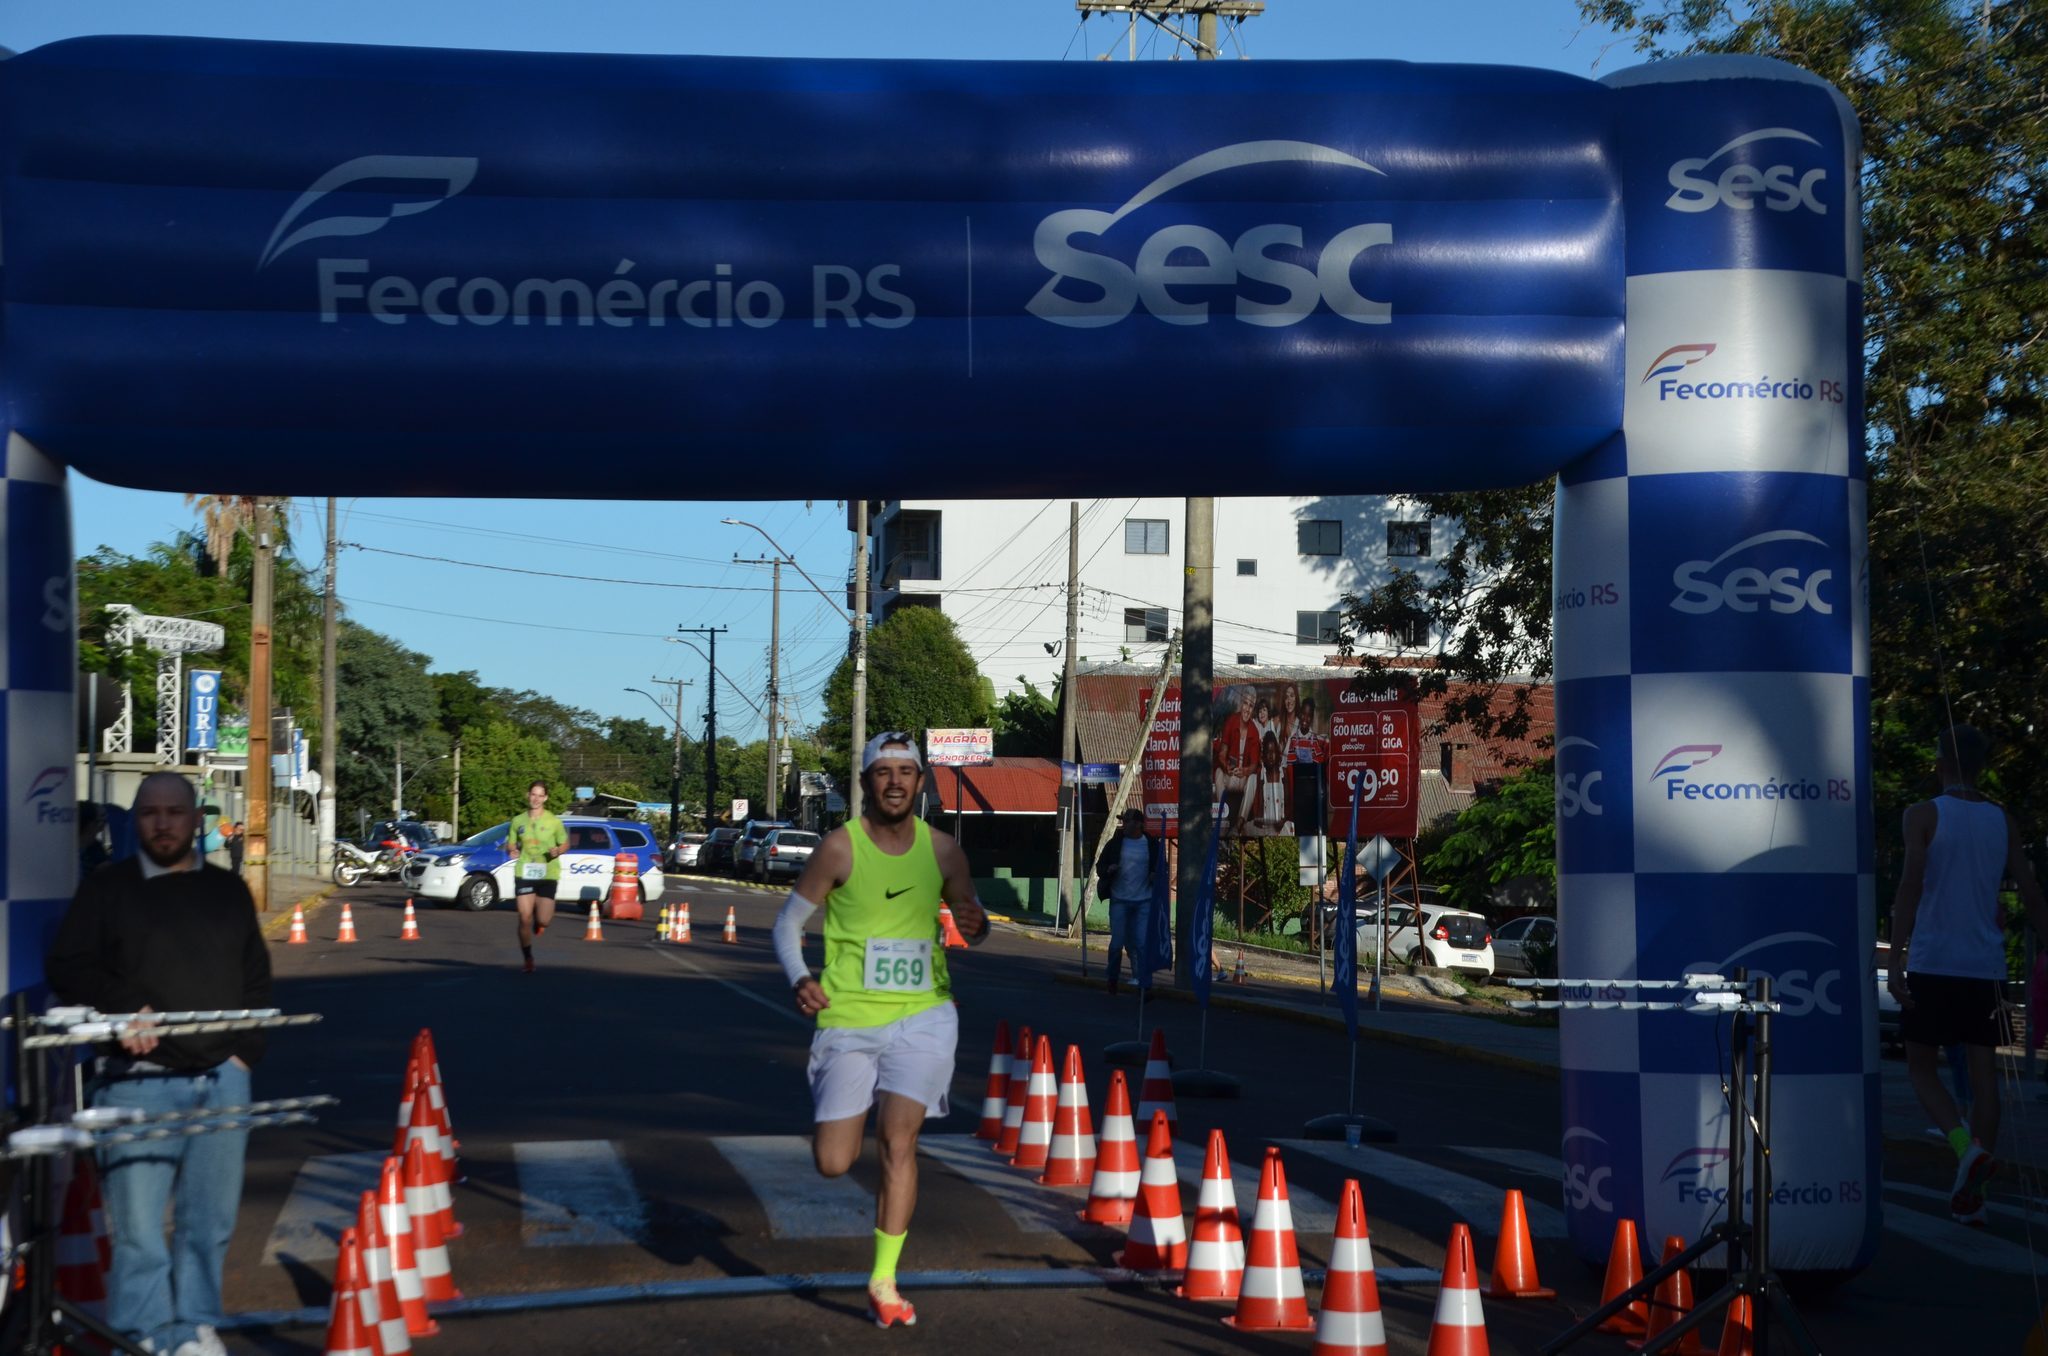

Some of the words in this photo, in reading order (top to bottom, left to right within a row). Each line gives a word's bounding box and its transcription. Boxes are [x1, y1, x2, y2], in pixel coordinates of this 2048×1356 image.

[1665, 157, 1827, 216] Sesc
[1024, 207, 1394, 328] Sesc
[316, 257, 785, 329] Fecomércio
[812, 263, 916, 329] RS
[1659, 376, 1814, 402] Fecomércio
[1820, 380, 1844, 404] RS
[1591, 583, 1620, 605] RS
[1669, 559, 1833, 615] Sesc
[194, 696, 213, 748] URI
[1333, 725, 1349, 736] 600
[1350, 724, 1374, 736] MEGA
[1382, 723, 1394, 735] 60
[1381, 738, 1403, 749] GIGA
[1154, 759, 1165, 770] na
[1337, 770, 1346, 782] R$
[1146, 775, 1174, 790] cidade.
[1667, 777, 1821, 800] Fecomércio
[1828, 779, 1850, 802] RS
[875, 957, 925, 985] 569
[1839, 1180, 1862, 1203] RS
